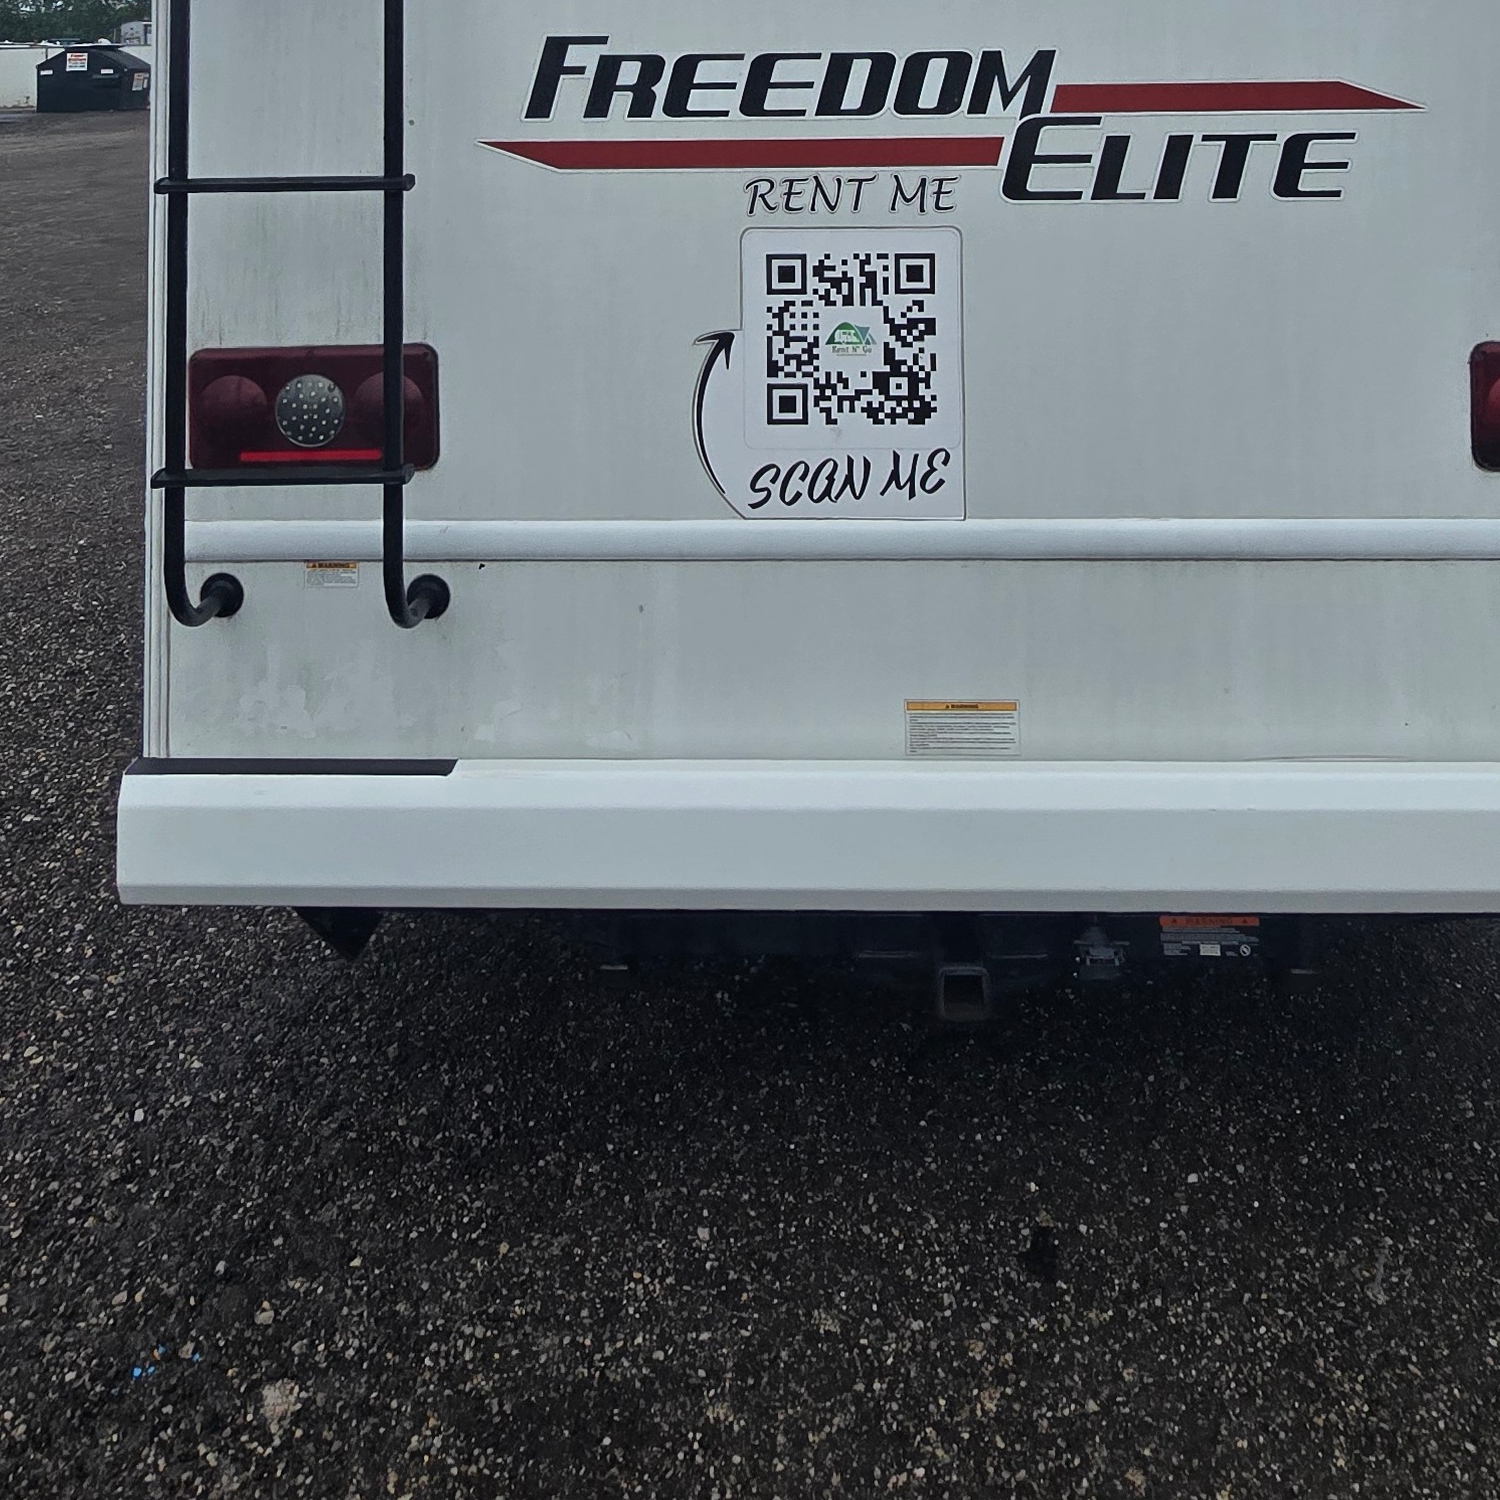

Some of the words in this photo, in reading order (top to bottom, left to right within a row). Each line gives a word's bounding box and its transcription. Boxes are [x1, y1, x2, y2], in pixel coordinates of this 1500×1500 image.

[523, 34, 1057, 120] FREEDOM
[745, 174, 878, 215] RENT
[890, 174, 959, 213] ME
[1000, 115, 1358, 202] ELITE
[747, 453, 871, 510] SCAN
[879, 447, 951, 501] ME
